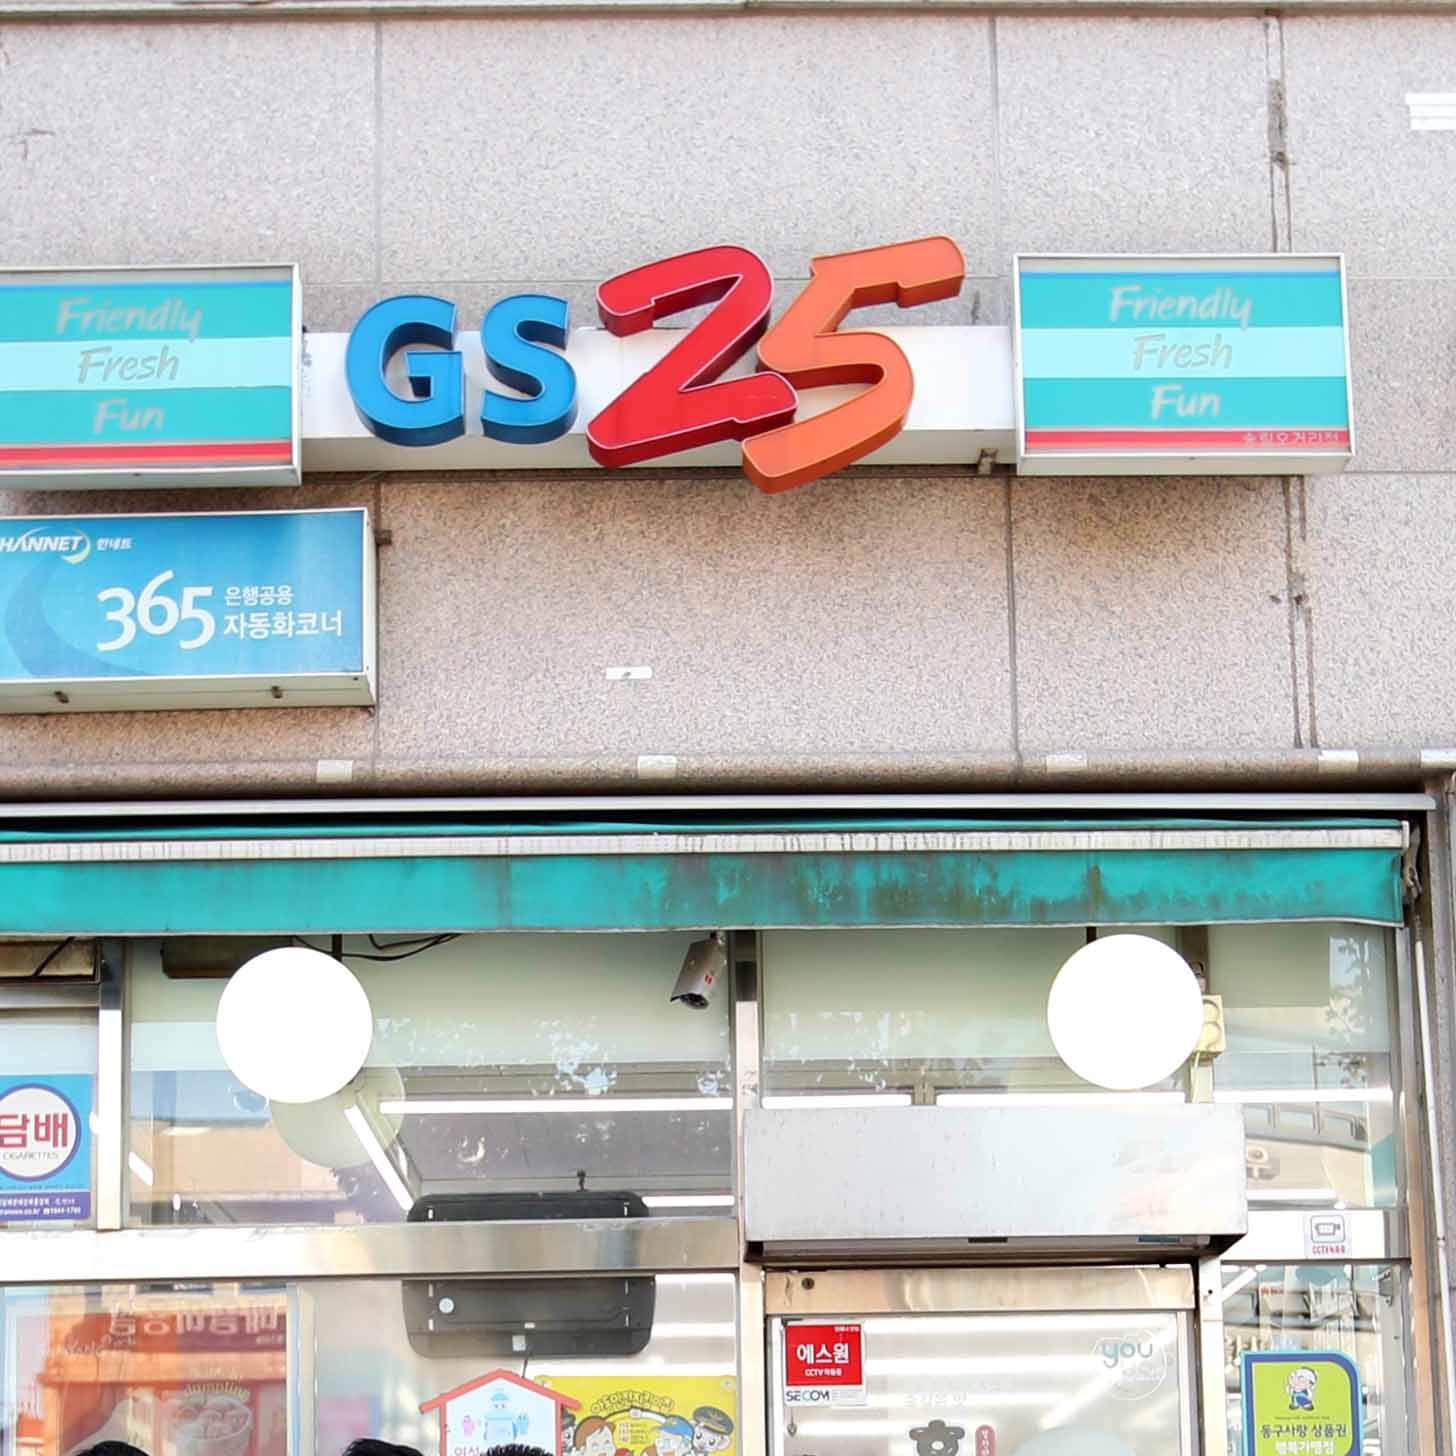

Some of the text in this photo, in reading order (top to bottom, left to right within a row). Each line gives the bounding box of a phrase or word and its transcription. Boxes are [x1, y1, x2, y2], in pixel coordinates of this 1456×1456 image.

[56, 297, 202, 339] Friendly
[1108, 286, 1253, 331] Friendly
[78, 347, 179, 383] Fresh
[345, 235, 966, 494] GS25
[1133, 334, 1232, 370] Fresh
[94, 398, 165, 434] Fun
[1150, 385, 1220, 419] Fun
[96, 570, 216, 651] 365
[224, 585, 294, 607] 은행공용
[223, 610, 343, 640] 자동화코너
[796, 1342, 849, 1364] 에스원
[786, 1390, 830, 1402] SECOM
[1261, 1424, 1347, 1439] 동구사랑 상품권
